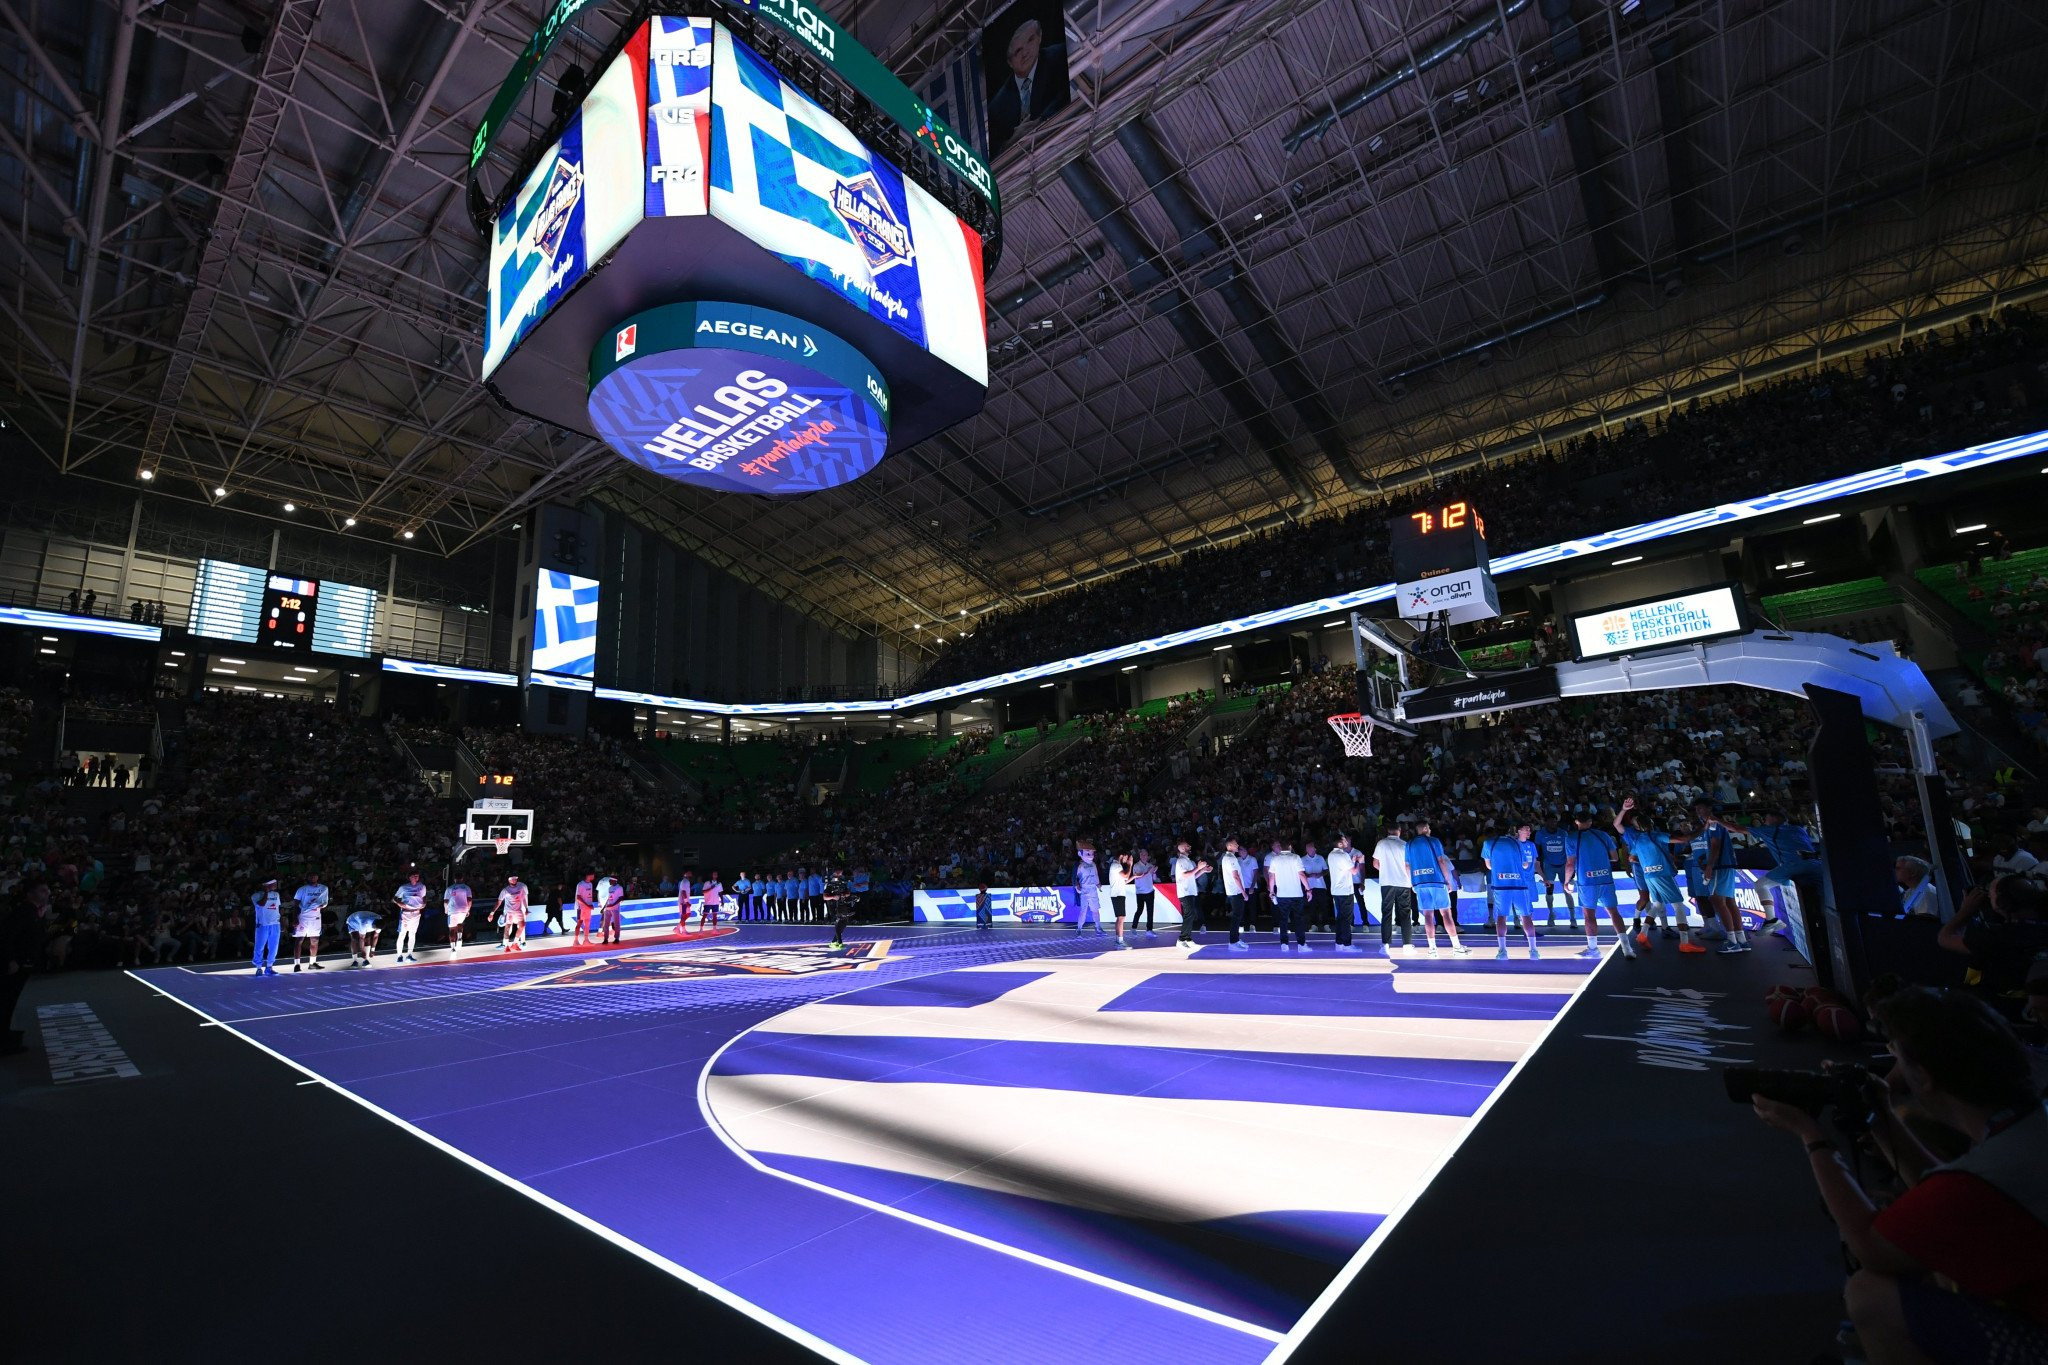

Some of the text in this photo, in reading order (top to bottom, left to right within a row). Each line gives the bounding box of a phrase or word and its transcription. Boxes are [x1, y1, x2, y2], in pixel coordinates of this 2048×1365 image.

[651, 165, 700, 182] FRA
[697, 320, 797, 348] AEGEAN
[643, 369, 788, 461] HELLAS
[689, 394, 822, 471] BASKETBALL
[1412, 503, 1466, 533] 7:12
[281, 597, 301, 610] 7:12
[1451, 592, 1472, 600] allwyn
[1630, 602, 1684, 620] HELLENIC
[1632, 608, 1709, 632] BASKETBALL
[268, 619, 304, 633] 0 0
[1635, 620, 1712, 642] FEDERATION
